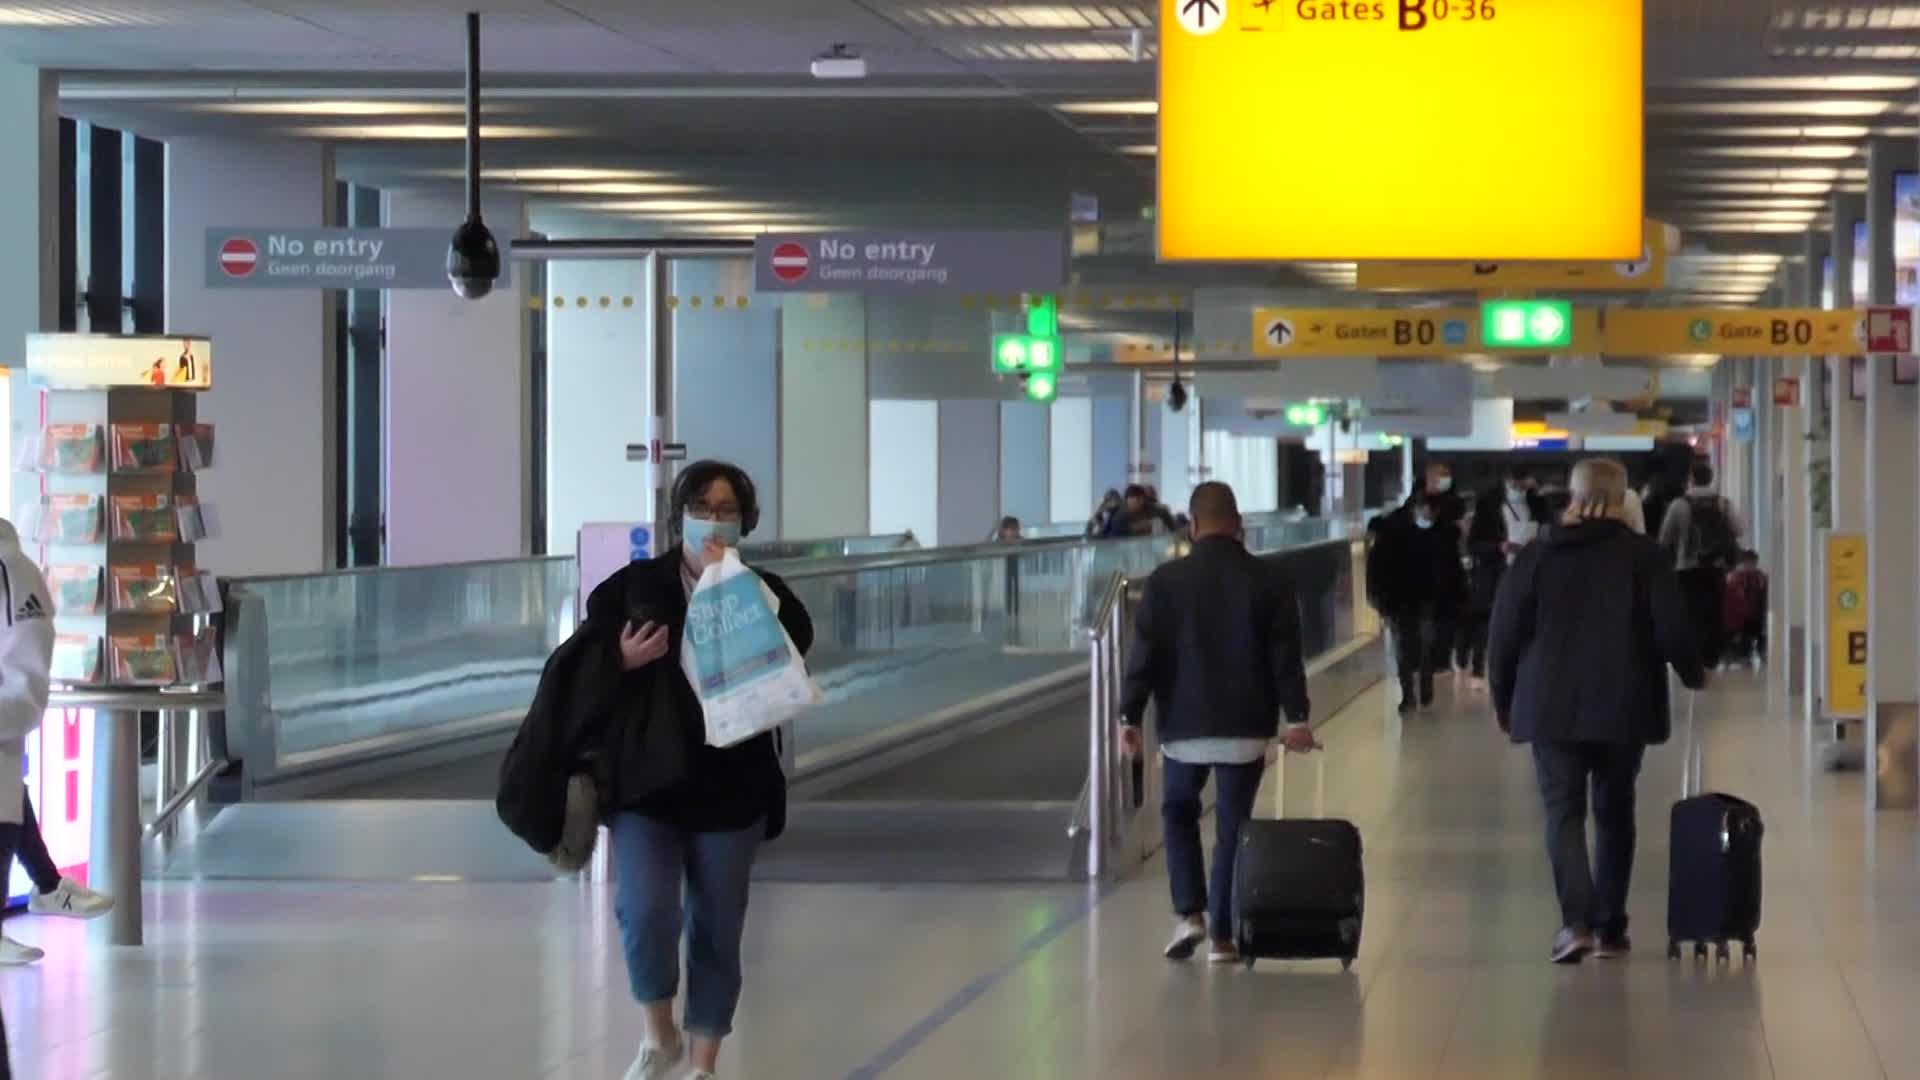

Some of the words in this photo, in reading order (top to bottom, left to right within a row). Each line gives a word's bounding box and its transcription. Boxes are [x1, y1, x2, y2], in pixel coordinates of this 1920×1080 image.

[1296, 0, 1385, 20] Gates
[268, 235, 304, 257] No
[313, 236, 383, 261] entry
[819, 239, 855, 260] No
[864, 240, 936, 264] entry
[268, 263, 310, 275] Geen
[316, 262, 396, 279] doorgang
[819, 265, 862, 280] Geen
[867, 265, 947, 283] doorgang
[1335, 324, 1387, 339] Gates
[1720, 323, 1763, 339] Gate
